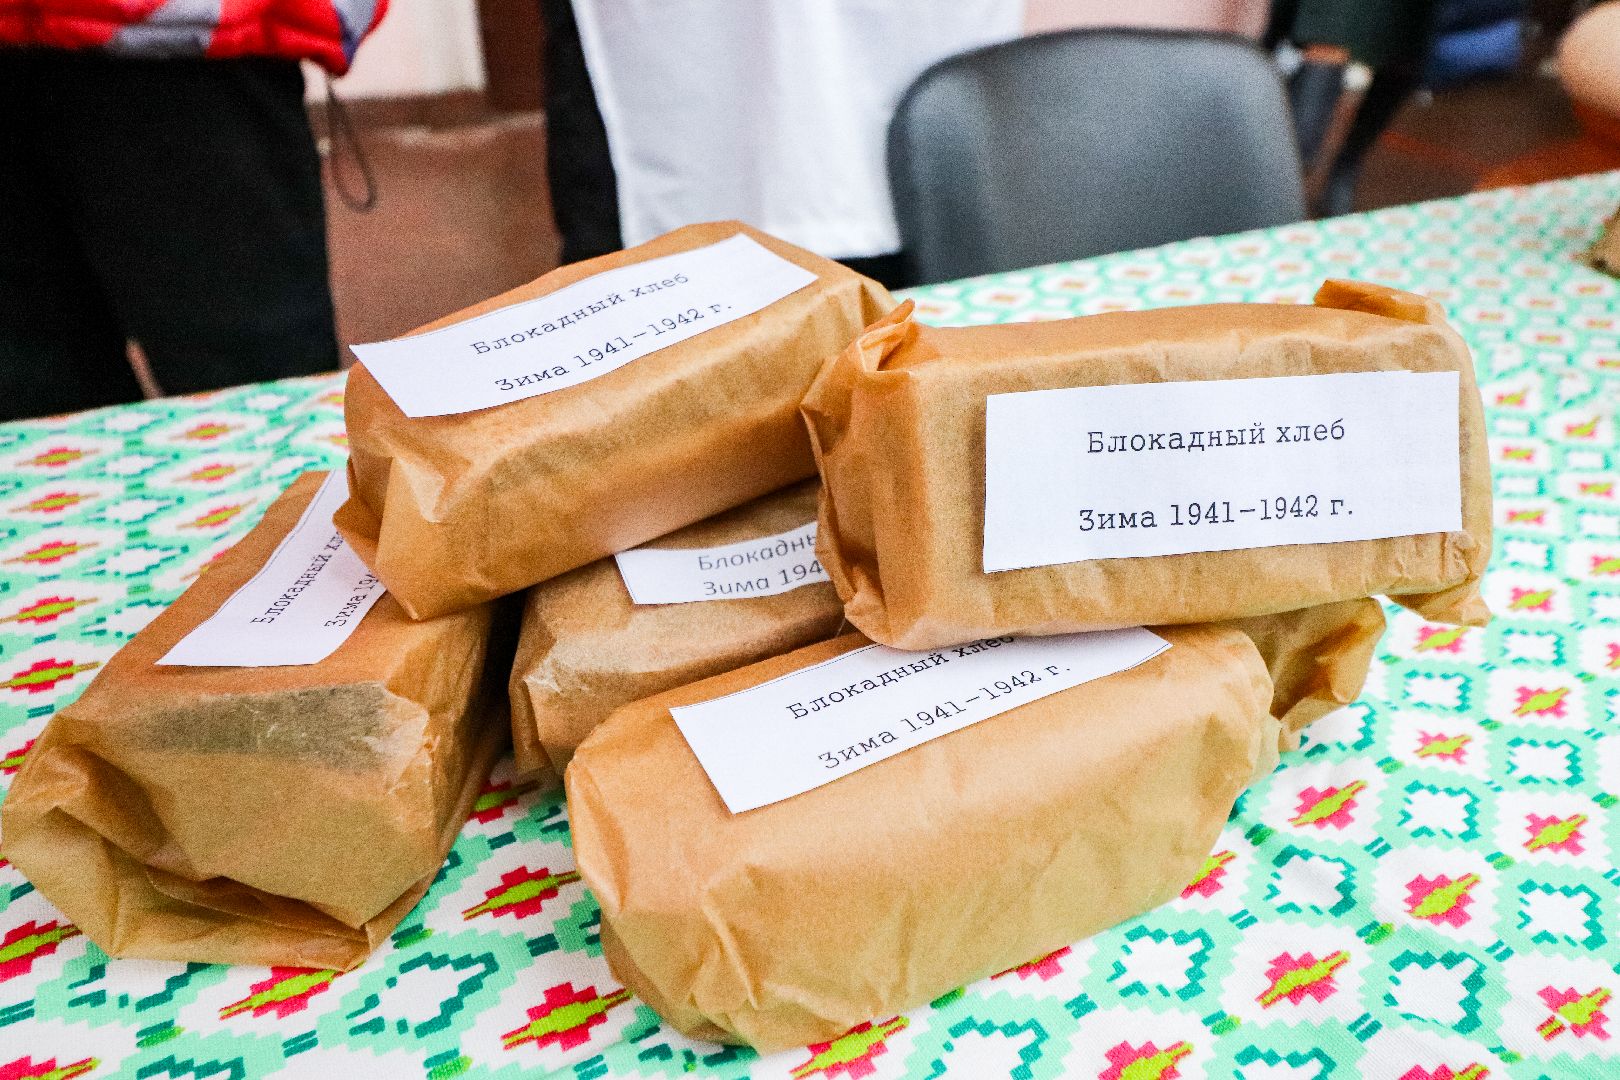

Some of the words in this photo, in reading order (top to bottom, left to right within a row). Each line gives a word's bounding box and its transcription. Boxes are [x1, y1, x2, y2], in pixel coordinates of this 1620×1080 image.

[469, 291, 626, 356] Блокадный
[629, 273, 690, 299] хлеб
[495, 363, 570, 392] Зима
[710, 302, 734, 316] г.
[1087, 421, 1266, 454] Блокадный
[1275, 418, 1346, 444] хлеб
[1078, 507, 1158, 532] Зима
[1329, 497, 1354, 516] г.
[249, 554, 333, 624] Блокадный
[324, 594, 368, 626] Зима
[704, 576, 770, 596] Зима
[786, 651, 950, 720] Блокадный
[817, 729, 898, 770] Зима
[1043, 663, 1072, 681] г.
